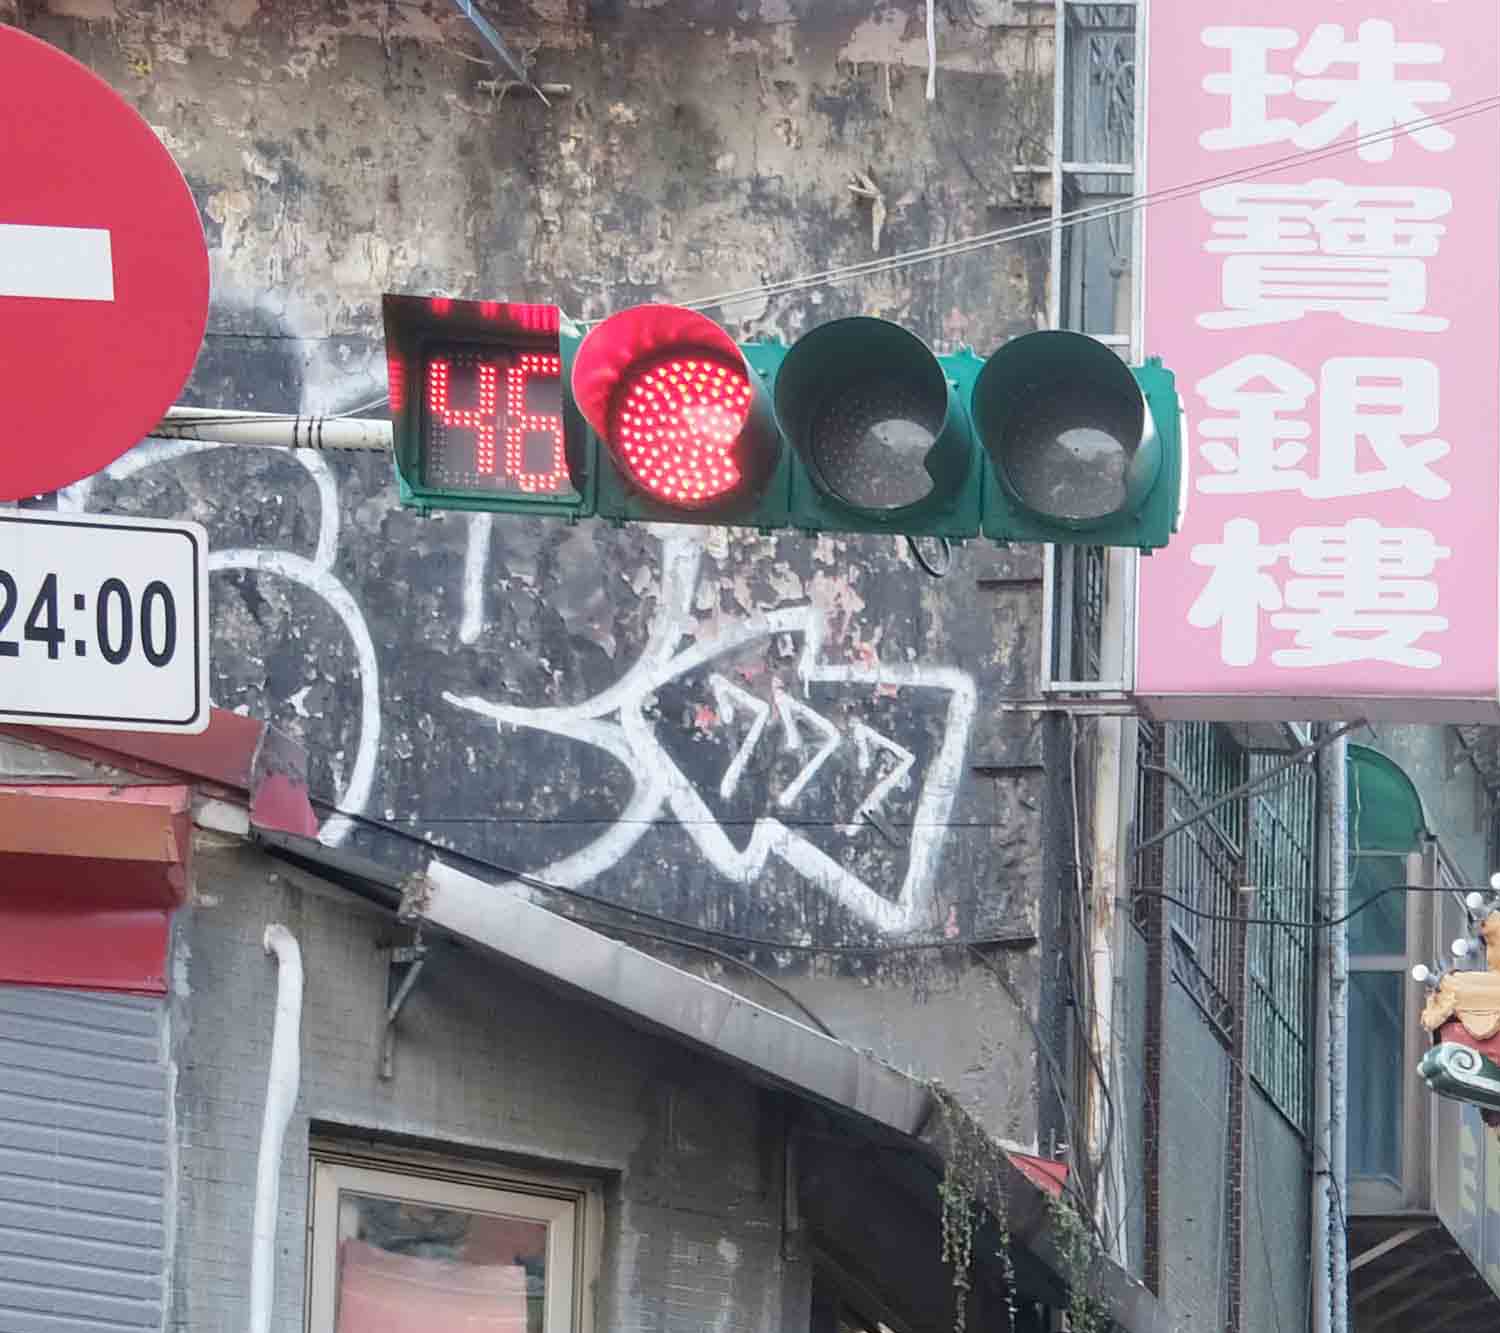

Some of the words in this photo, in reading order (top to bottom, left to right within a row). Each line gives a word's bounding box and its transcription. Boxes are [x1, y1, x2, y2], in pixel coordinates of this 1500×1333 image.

[428, 355, 568, 490] 46
[1188, 18, 1455, 670] 珠寶銀樓
